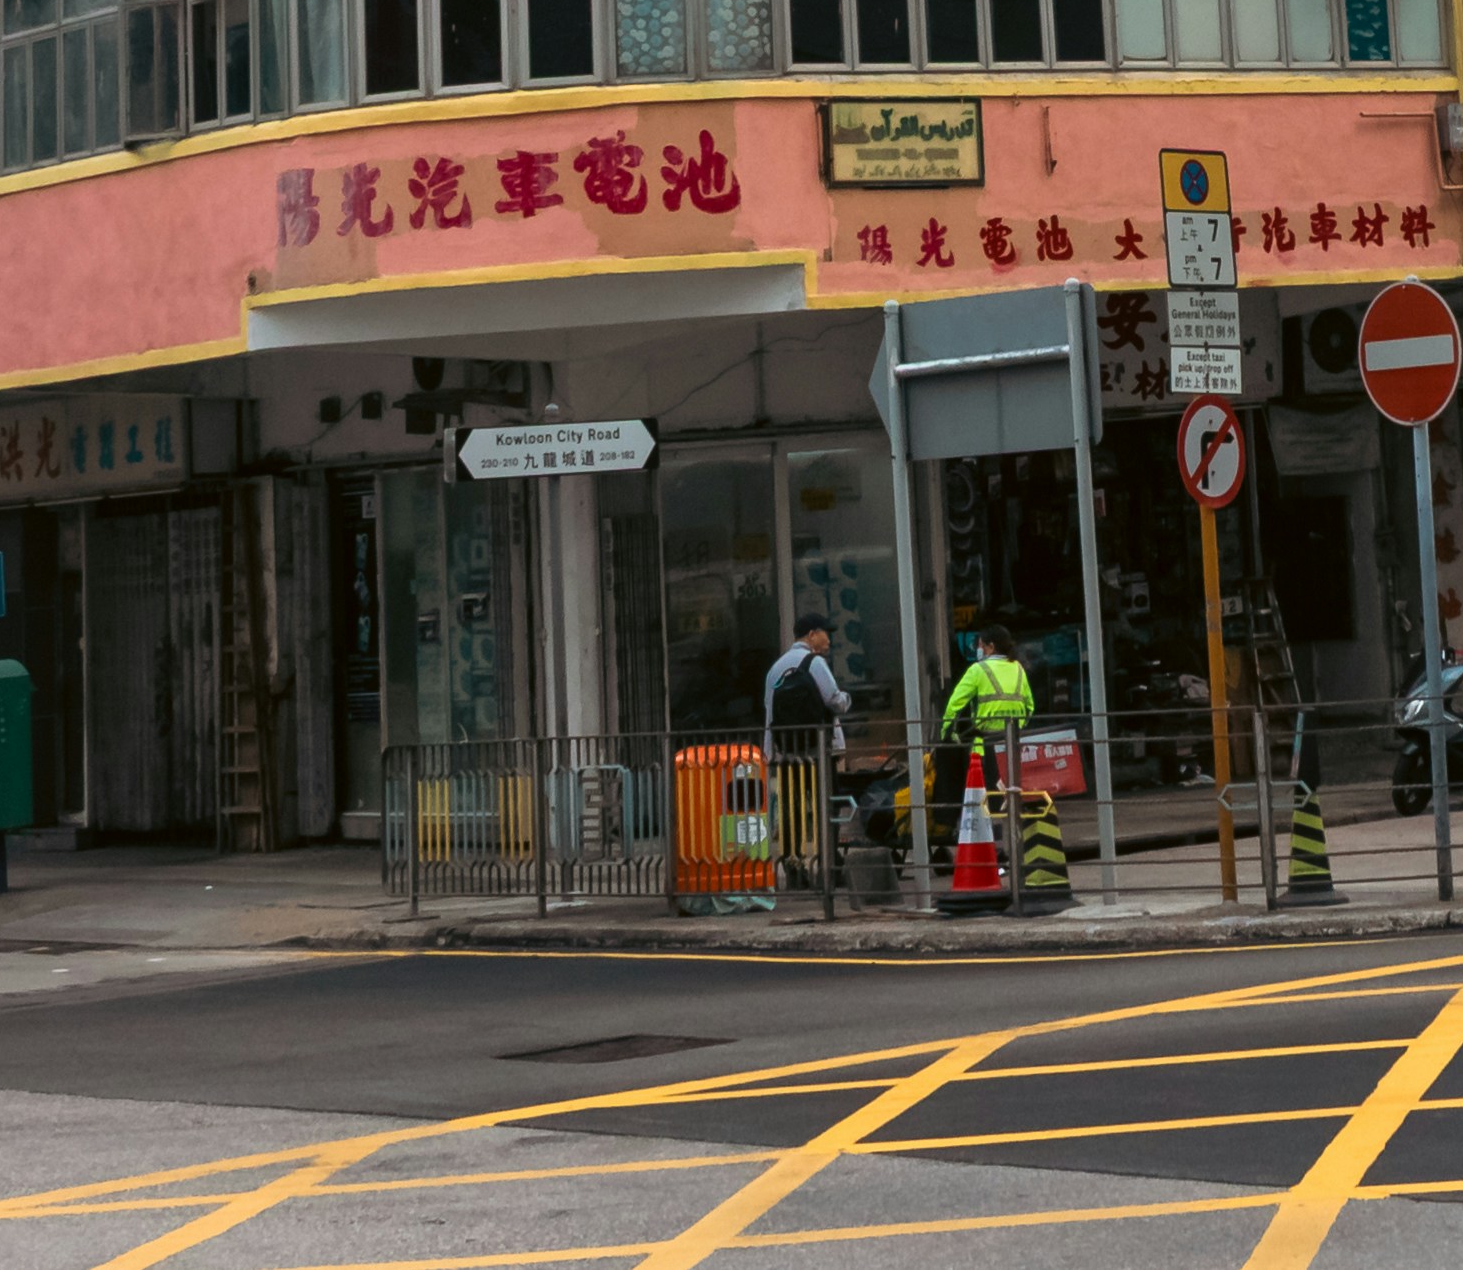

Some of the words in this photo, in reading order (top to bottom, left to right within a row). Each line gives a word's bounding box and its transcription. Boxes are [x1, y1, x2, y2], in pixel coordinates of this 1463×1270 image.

[276, 129, 741, 247] 陽光汽車電池
[858, 203, 1436, 268] 陽光電池大汽車材料
[1180, 227, 1198, 241] 上午
[1207, 218, 1218, 242] 7
[1210, 257, 1221, 280] 7
[1189, 297, 1216, 310] Except
[1172, 308, 1200, 320] General
[1202, 309, 1236, 322] Holidays
[1187, 351, 1211, 363] Except
[1212, 352, 1226, 362] taxi
[496, 433, 552, 446] Kowloon
[557, 430, 583, 444] City
[588, 427, 620, 441] Road
[524, 449, 595, 470] 九龍城道
